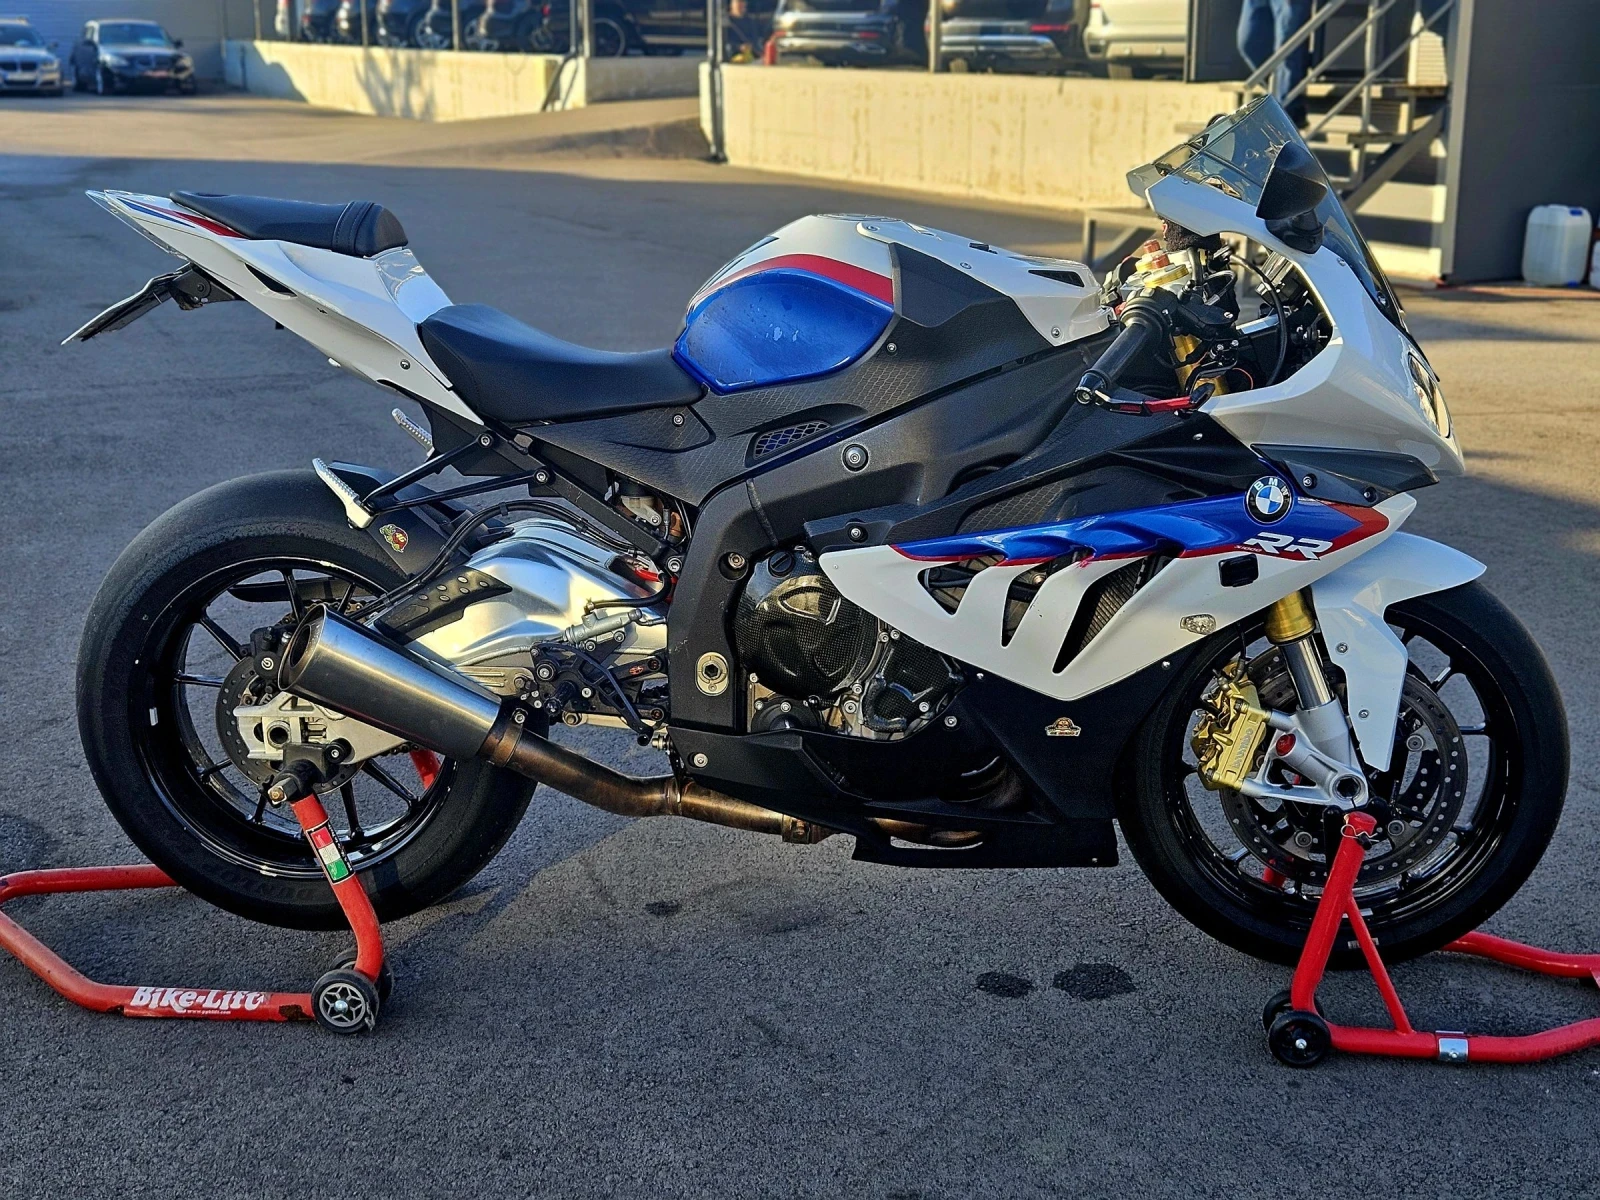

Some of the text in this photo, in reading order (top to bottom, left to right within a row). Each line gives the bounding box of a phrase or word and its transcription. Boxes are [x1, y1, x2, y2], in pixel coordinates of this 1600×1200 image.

[1254, 477, 1289, 496] BMW
[1243, 532, 1333, 560] RR
[130, 986, 264, 1013] Bike-Lift
